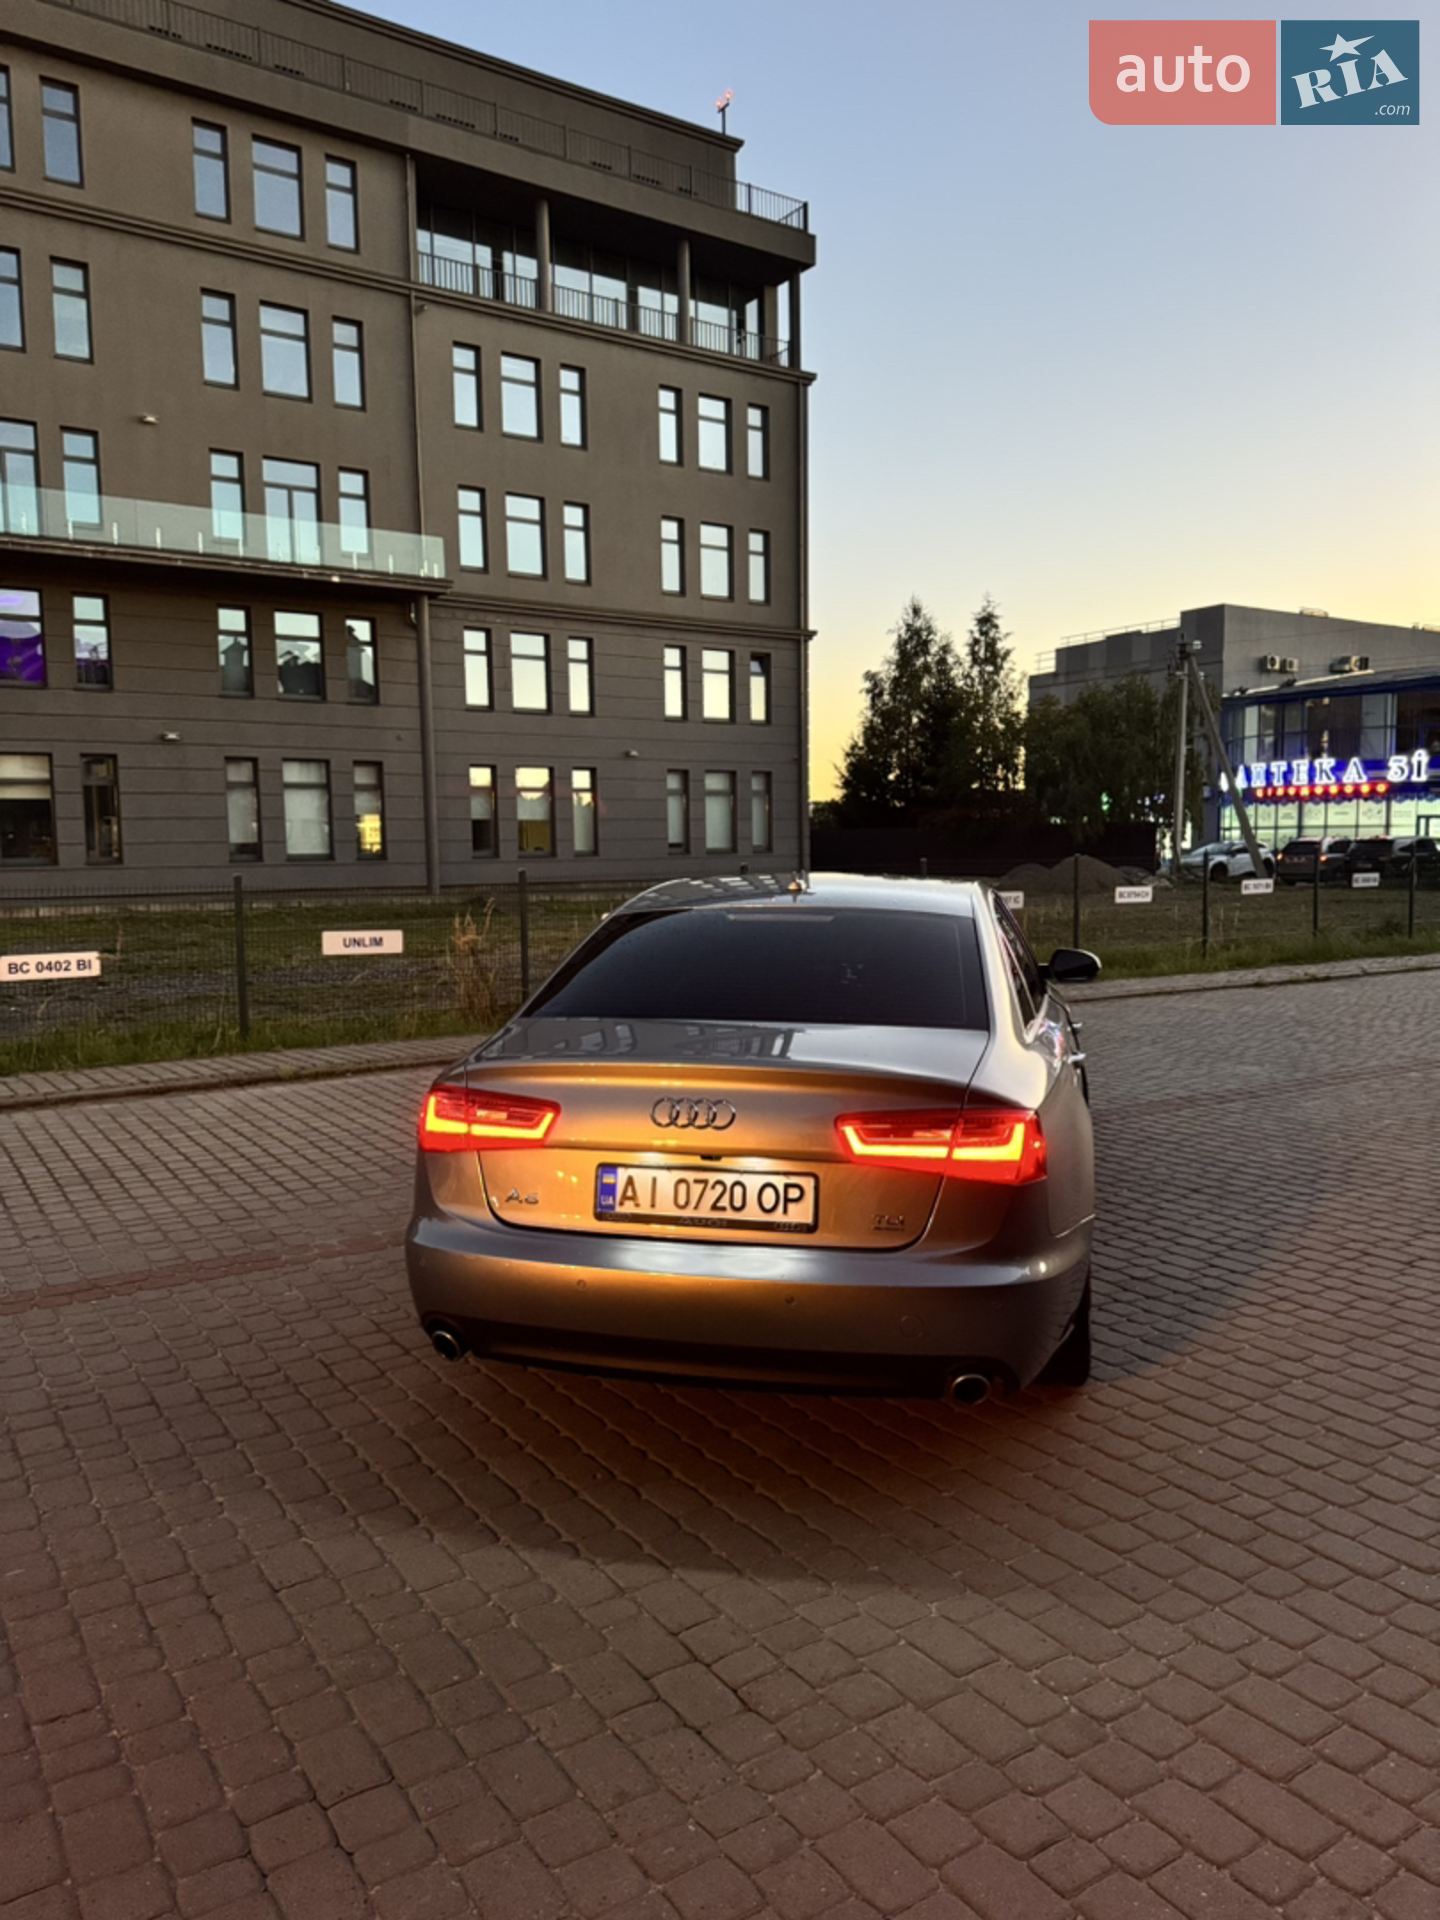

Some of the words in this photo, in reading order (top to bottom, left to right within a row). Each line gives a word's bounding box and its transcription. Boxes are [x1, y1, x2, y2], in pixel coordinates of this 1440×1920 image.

[1234, 757, 1368, 789] АПТЕКА
[342, 936, 384, 948] UNLIM
[8, 961, 31, 975] BC
[35, 959, 72, 973] 0402
[76, 958, 92, 971] BI
[600, 1195, 615, 1206] UA
[618, 1175, 657, 1208] AI
[673, 1178, 747, 1212] 0720
[757, 1183, 805, 1215] OP
